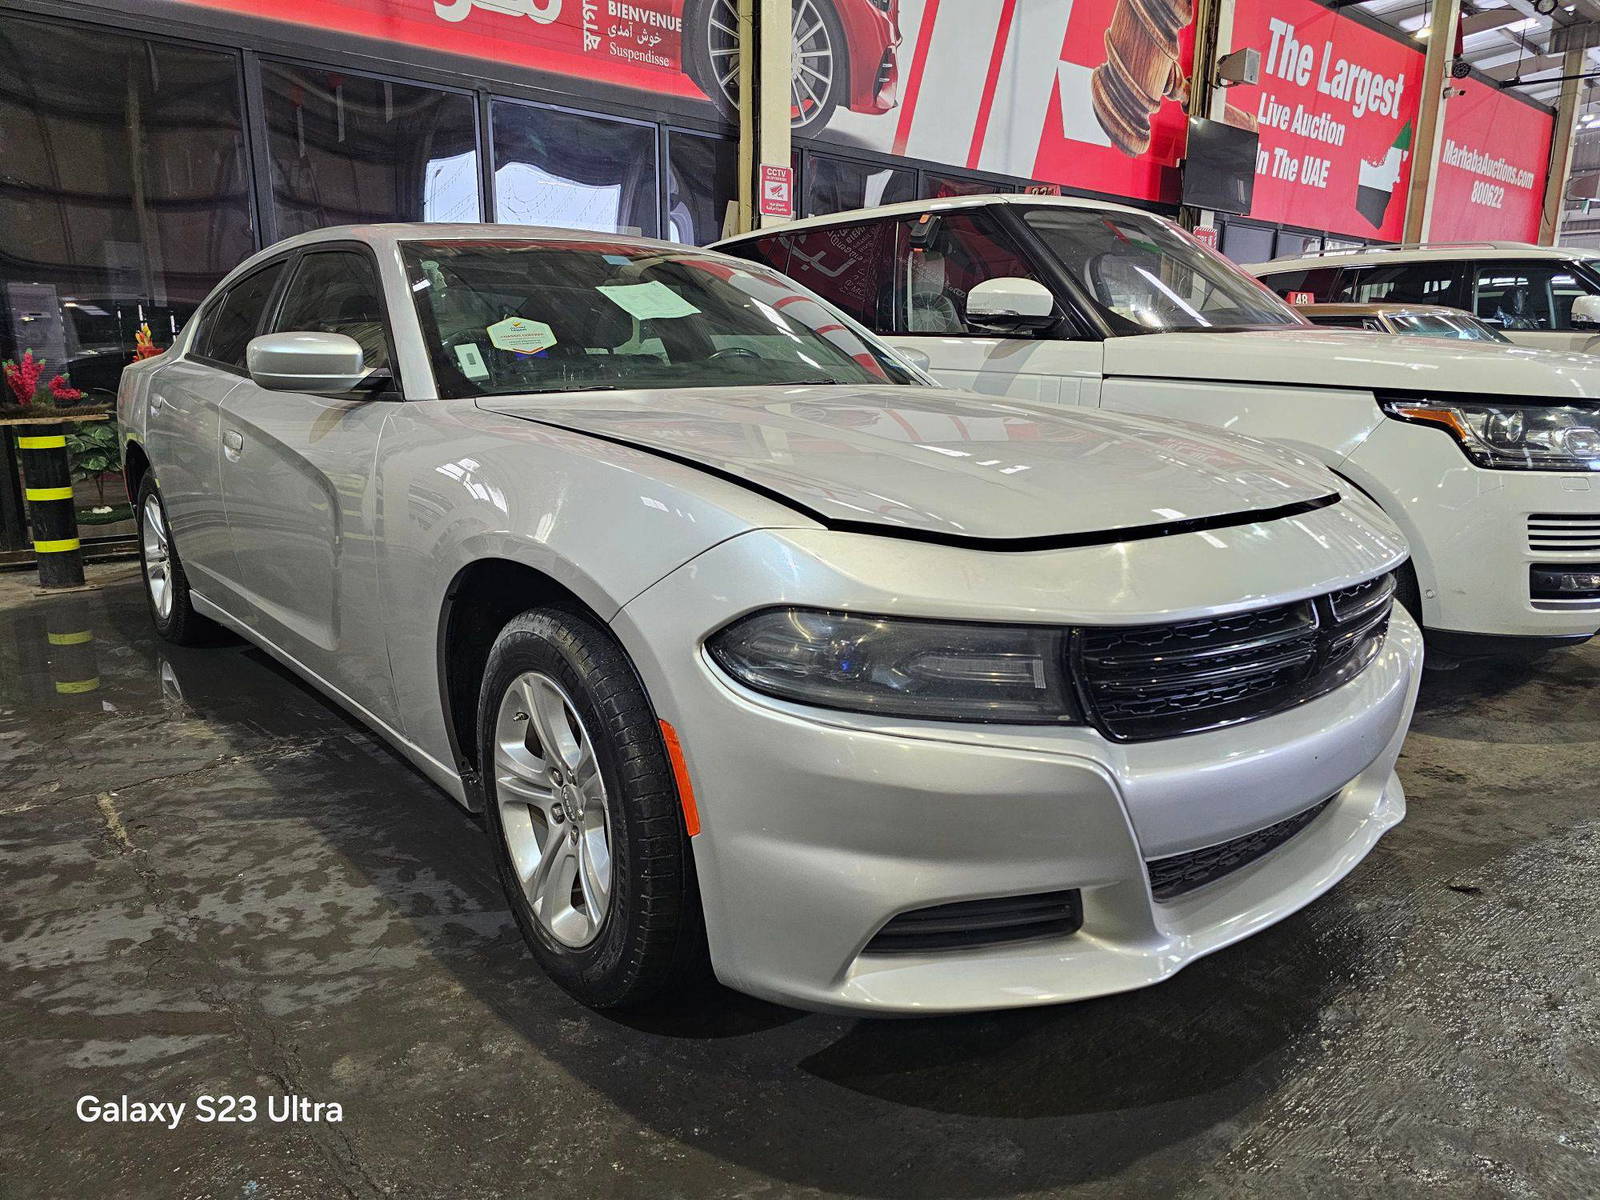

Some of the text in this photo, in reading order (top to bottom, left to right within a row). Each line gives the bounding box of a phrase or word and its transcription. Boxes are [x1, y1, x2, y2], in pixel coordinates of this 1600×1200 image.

[608, 1, 682, 32] BIENVENUE
[637, 28, 662, 47] خوش
[609, 41, 670, 67] Suspendisse
[1265, 17, 1405, 120] The Largest
[1257, 92, 1346, 147] Live Auction
[766, 168, 787, 177] CCTV
[1255, 142, 1331, 189] In The UAE
[1442, 139, 1535, 190] MarhabaAuctions.com
[1471, 180, 1505, 209] 800622
[1296, 293, 1308, 304] 48
